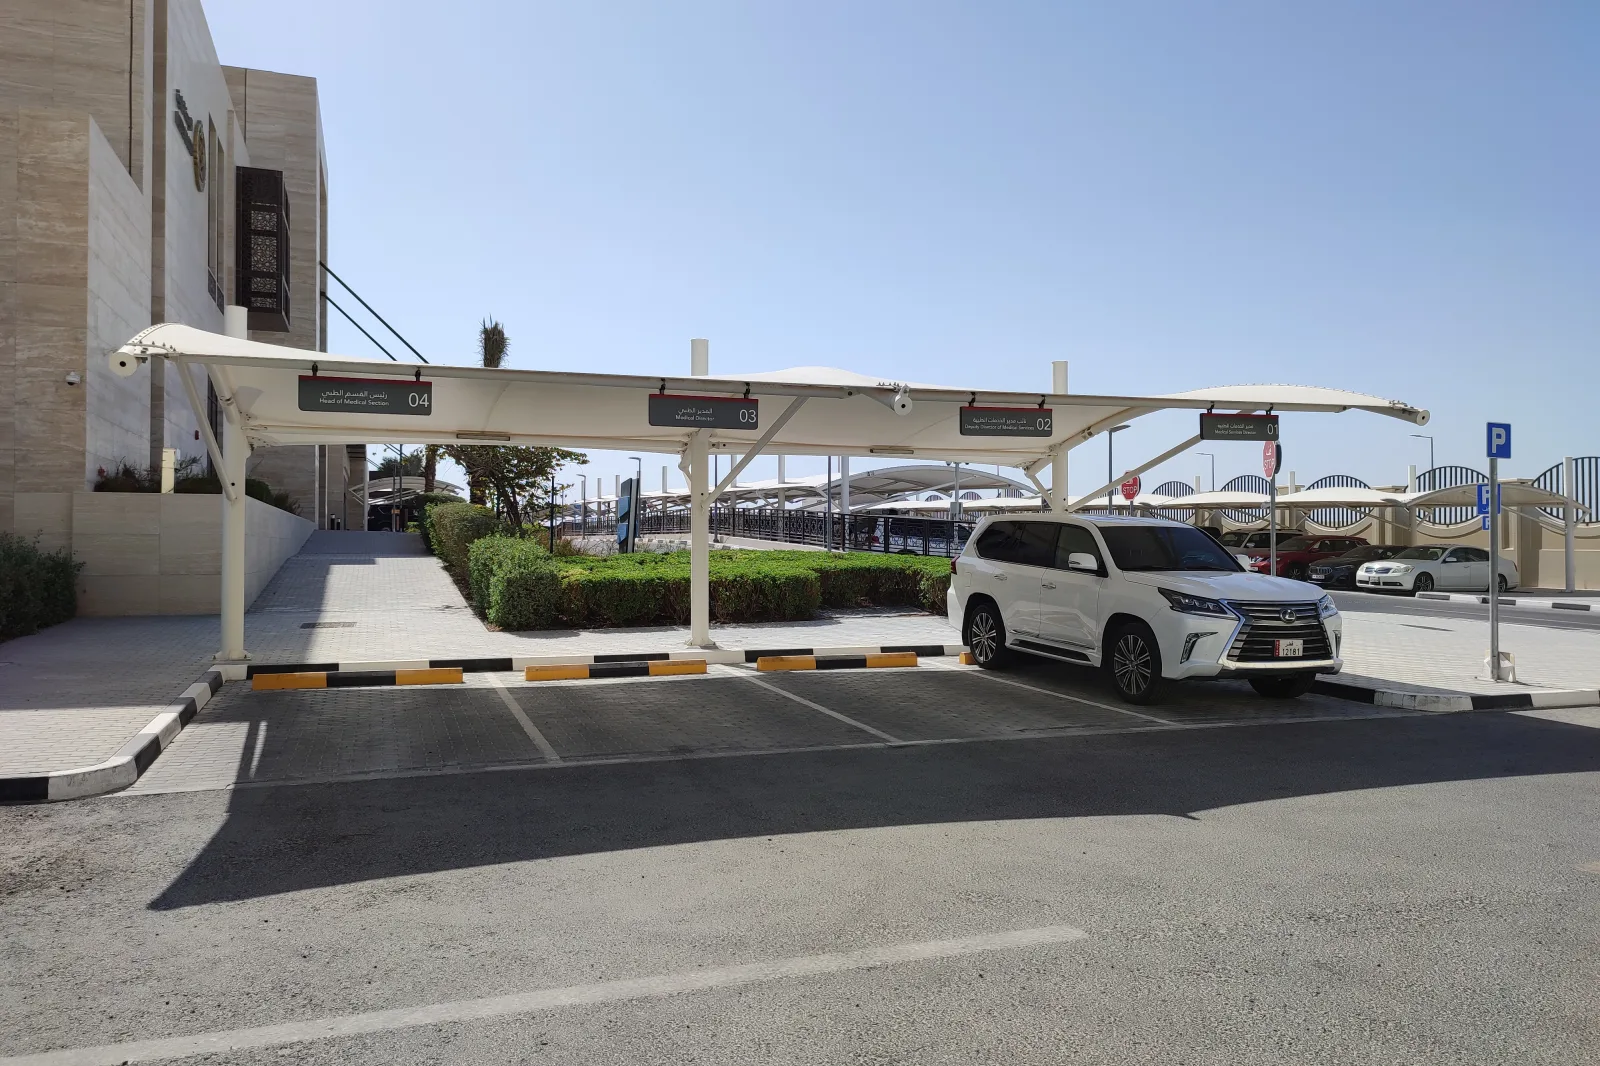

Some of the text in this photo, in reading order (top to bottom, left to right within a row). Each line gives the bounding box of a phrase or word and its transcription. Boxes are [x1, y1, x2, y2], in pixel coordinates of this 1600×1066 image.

[321, 389, 388, 399] رئيس القسم الطبي
[408, 392, 430, 408] 04
[739, 409, 757, 423] 03
[1036, 418, 1052, 431] 02
[1267, 423, 1278, 435] 01
[1491, 427, 1506, 454] P
[1264, 458, 1275, 471] STOP
[1122, 485, 1138, 495] STOP
[1282, 648, 1300, 656] 12181
